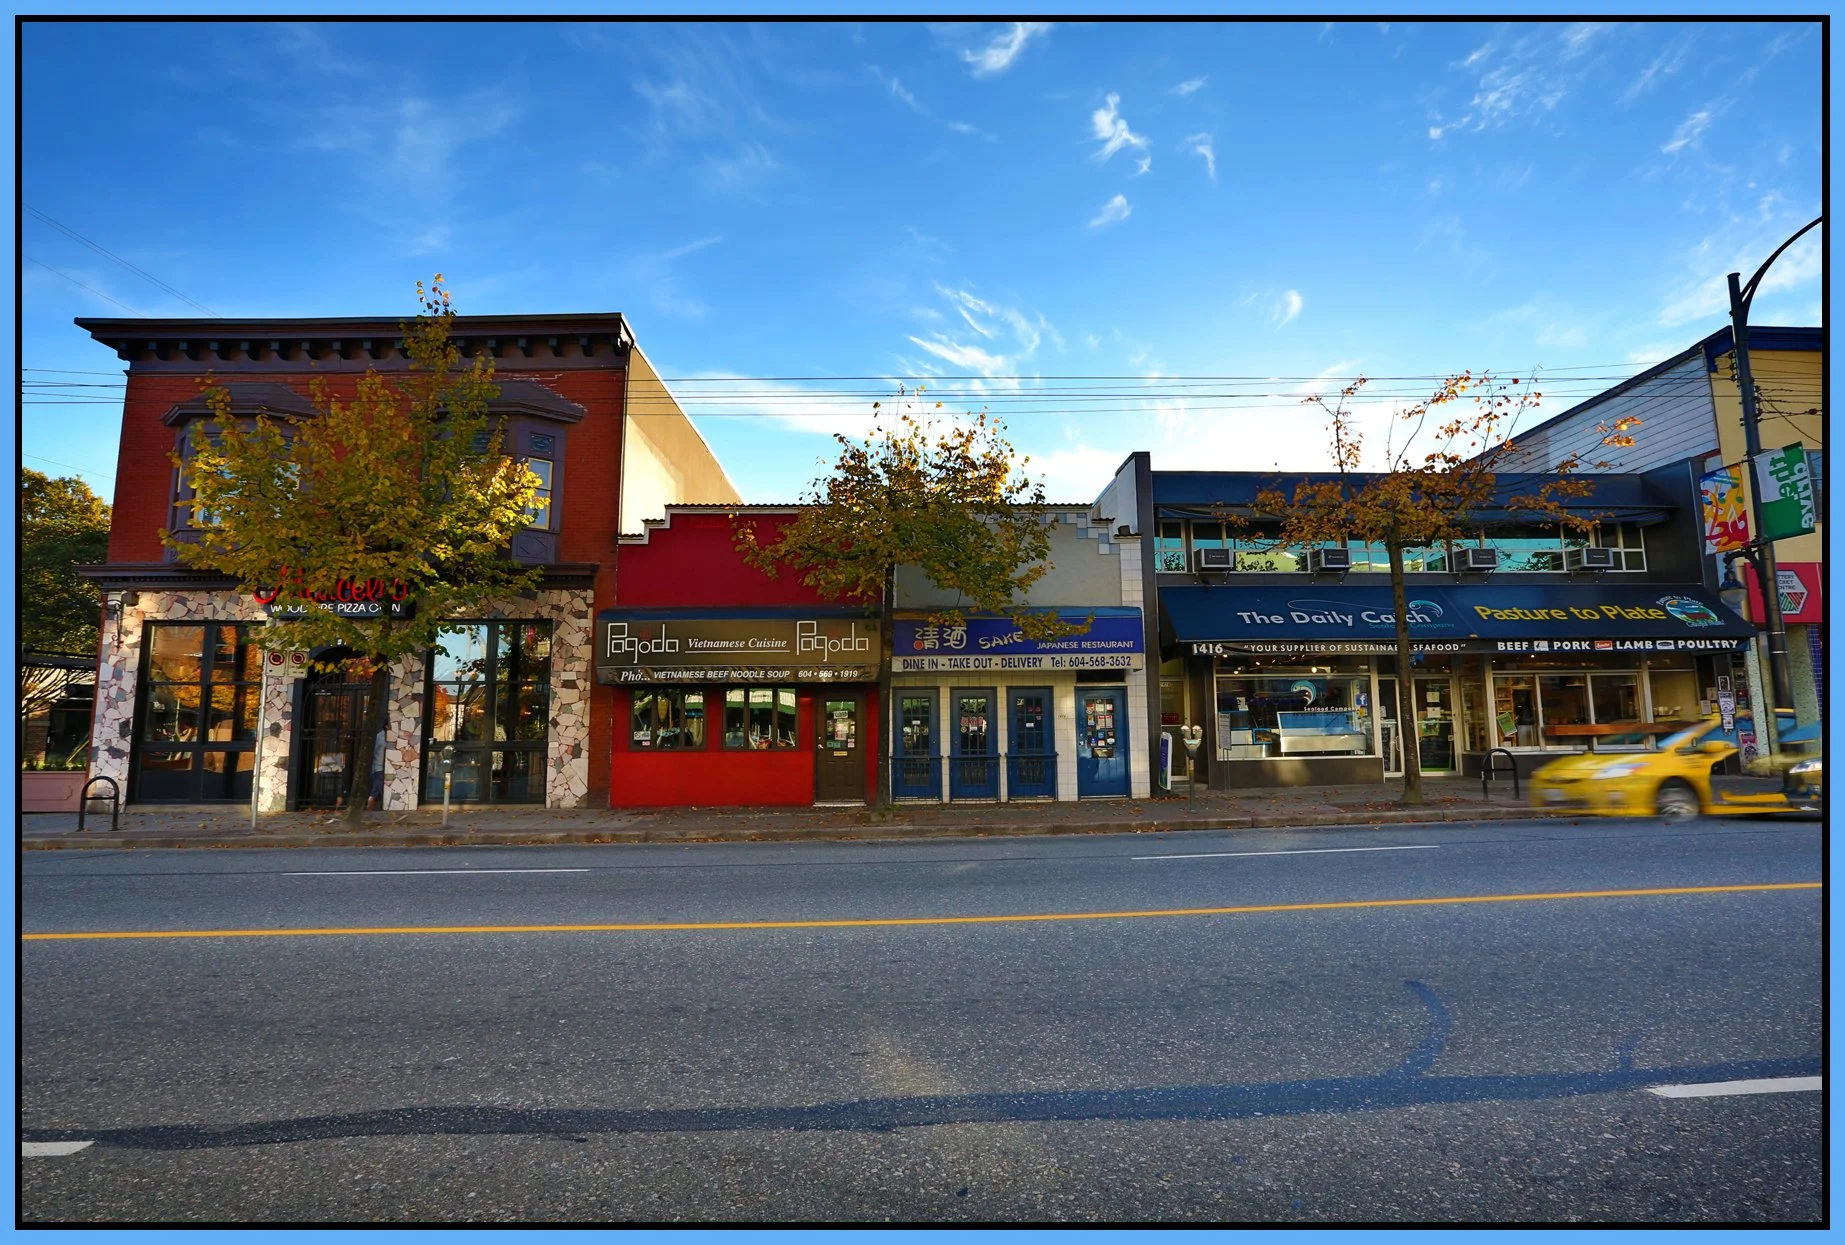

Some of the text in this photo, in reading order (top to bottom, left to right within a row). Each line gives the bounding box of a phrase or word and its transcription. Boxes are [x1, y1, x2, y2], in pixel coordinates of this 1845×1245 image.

[337, 603, 366, 612] PIZZA
[368, 603, 401, 612] ON
[1473, 605, 1668, 620] Pasture to Plate
[1236, 610, 1432, 627] The Daily Cach
[607, 622, 679, 664] Pagoda
[688, 638, 787, 649] Vietnamese Cuisine
[796, 620, 869, 662] Pagoda
[978, 631, 1024, 650] SAKE
[1037, 641, 1134, 650] JAPANESE RESTAURANT
[1553, 641, 1591, 650] PORK
[1616, 640, 1653, 649] LAMB
[1678, 640, 1738, 649] POULTRY
[1192, 643, 1224, 654] 1416
[1280, 644, 1326, 652] SUPPLIER
[1329, 644, 1342, 652] OF
[1497, 641, 1529, 651] BEEF
[903, 658, 925, 670] DINE
[928, 658, 939, 669] IN
[948, 658, 971, 669] TAKE
[973, 658, 993, 668] OUT
[1001, 657, 1043, 669] DELIVERY
[1051, 656, 1066, 668] Tel:
[1068, 656, 1132, 668] 604-568-3632
[654, 670, 705, 679] VIETNAMESE
[707, 670, 729, 679] BEEF
[730, 670, 765, 679] NOODLE
[767, 670, 791, 678] SOUP
[798, 670, 812, 678] 604
[819, 670, 833, 678] 569
[840, 670, 858, 678] 1919
